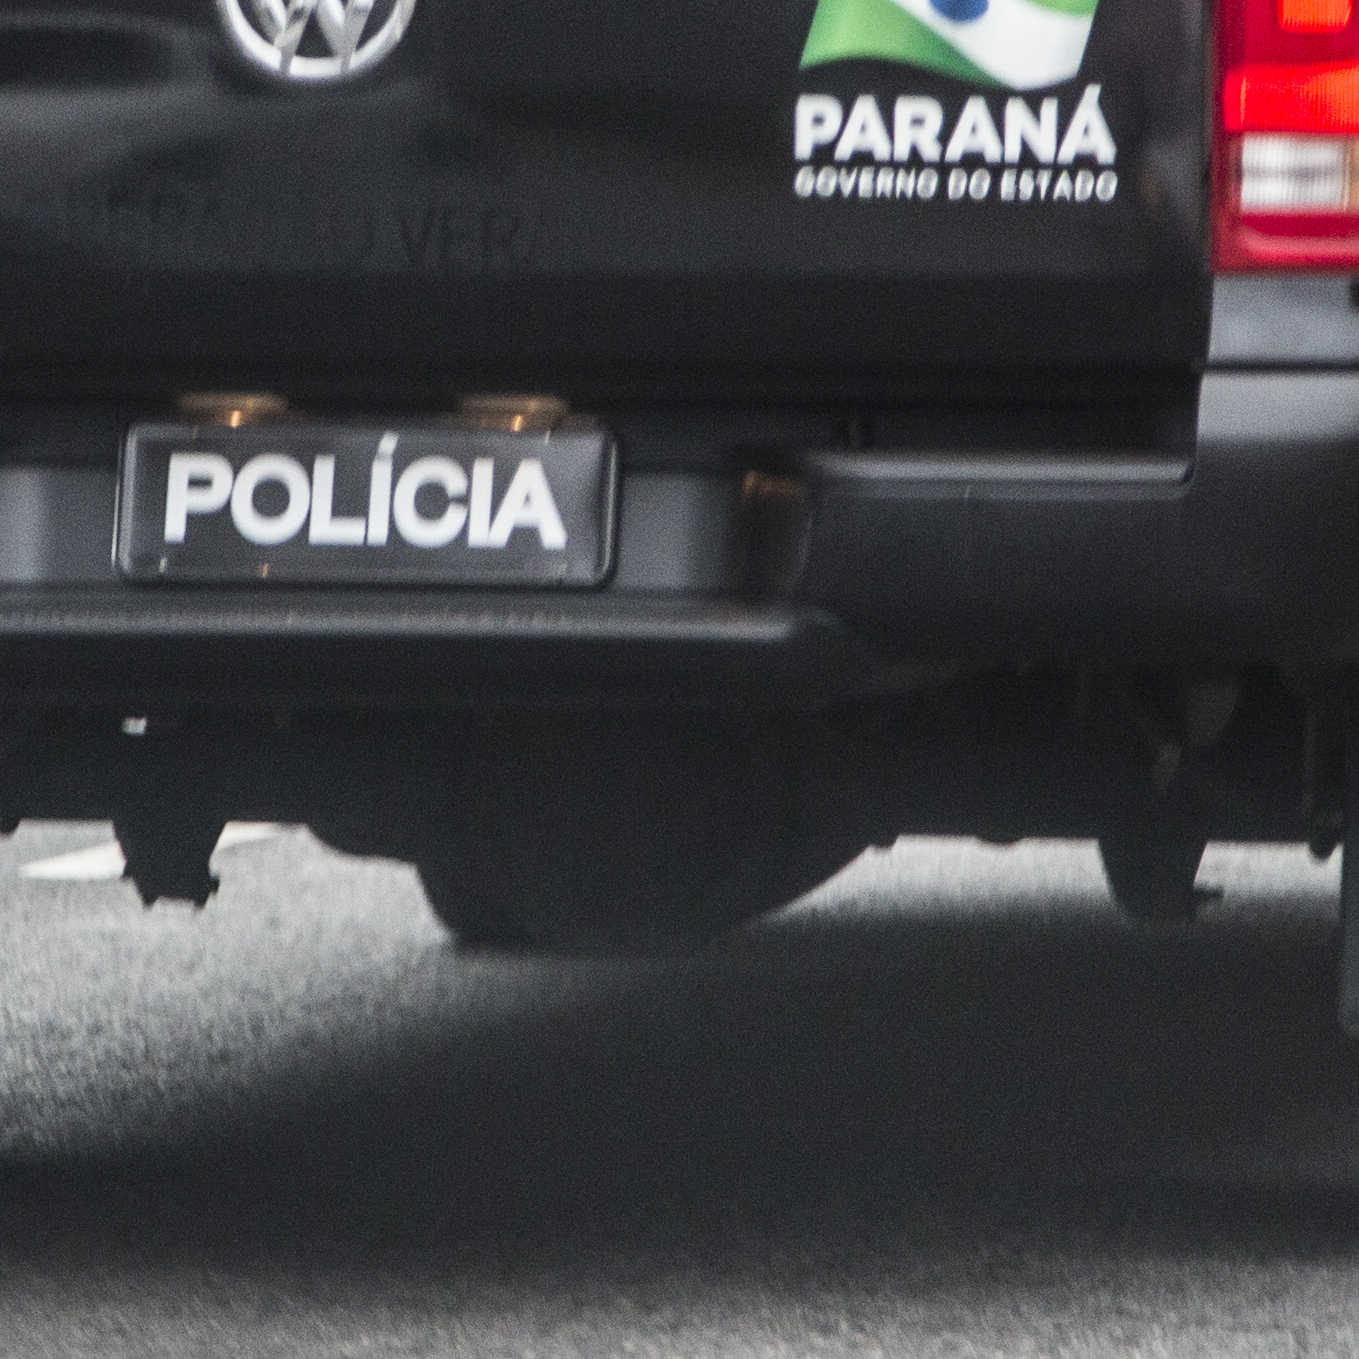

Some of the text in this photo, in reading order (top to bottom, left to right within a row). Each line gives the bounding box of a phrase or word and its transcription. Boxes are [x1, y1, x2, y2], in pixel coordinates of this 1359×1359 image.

[793, 83, 1118, 166] PARANÁ
[793, 165, 1119, 203] GOVERNO DO ESTADO
[163, 430, 568, 551] POLÍCIA
